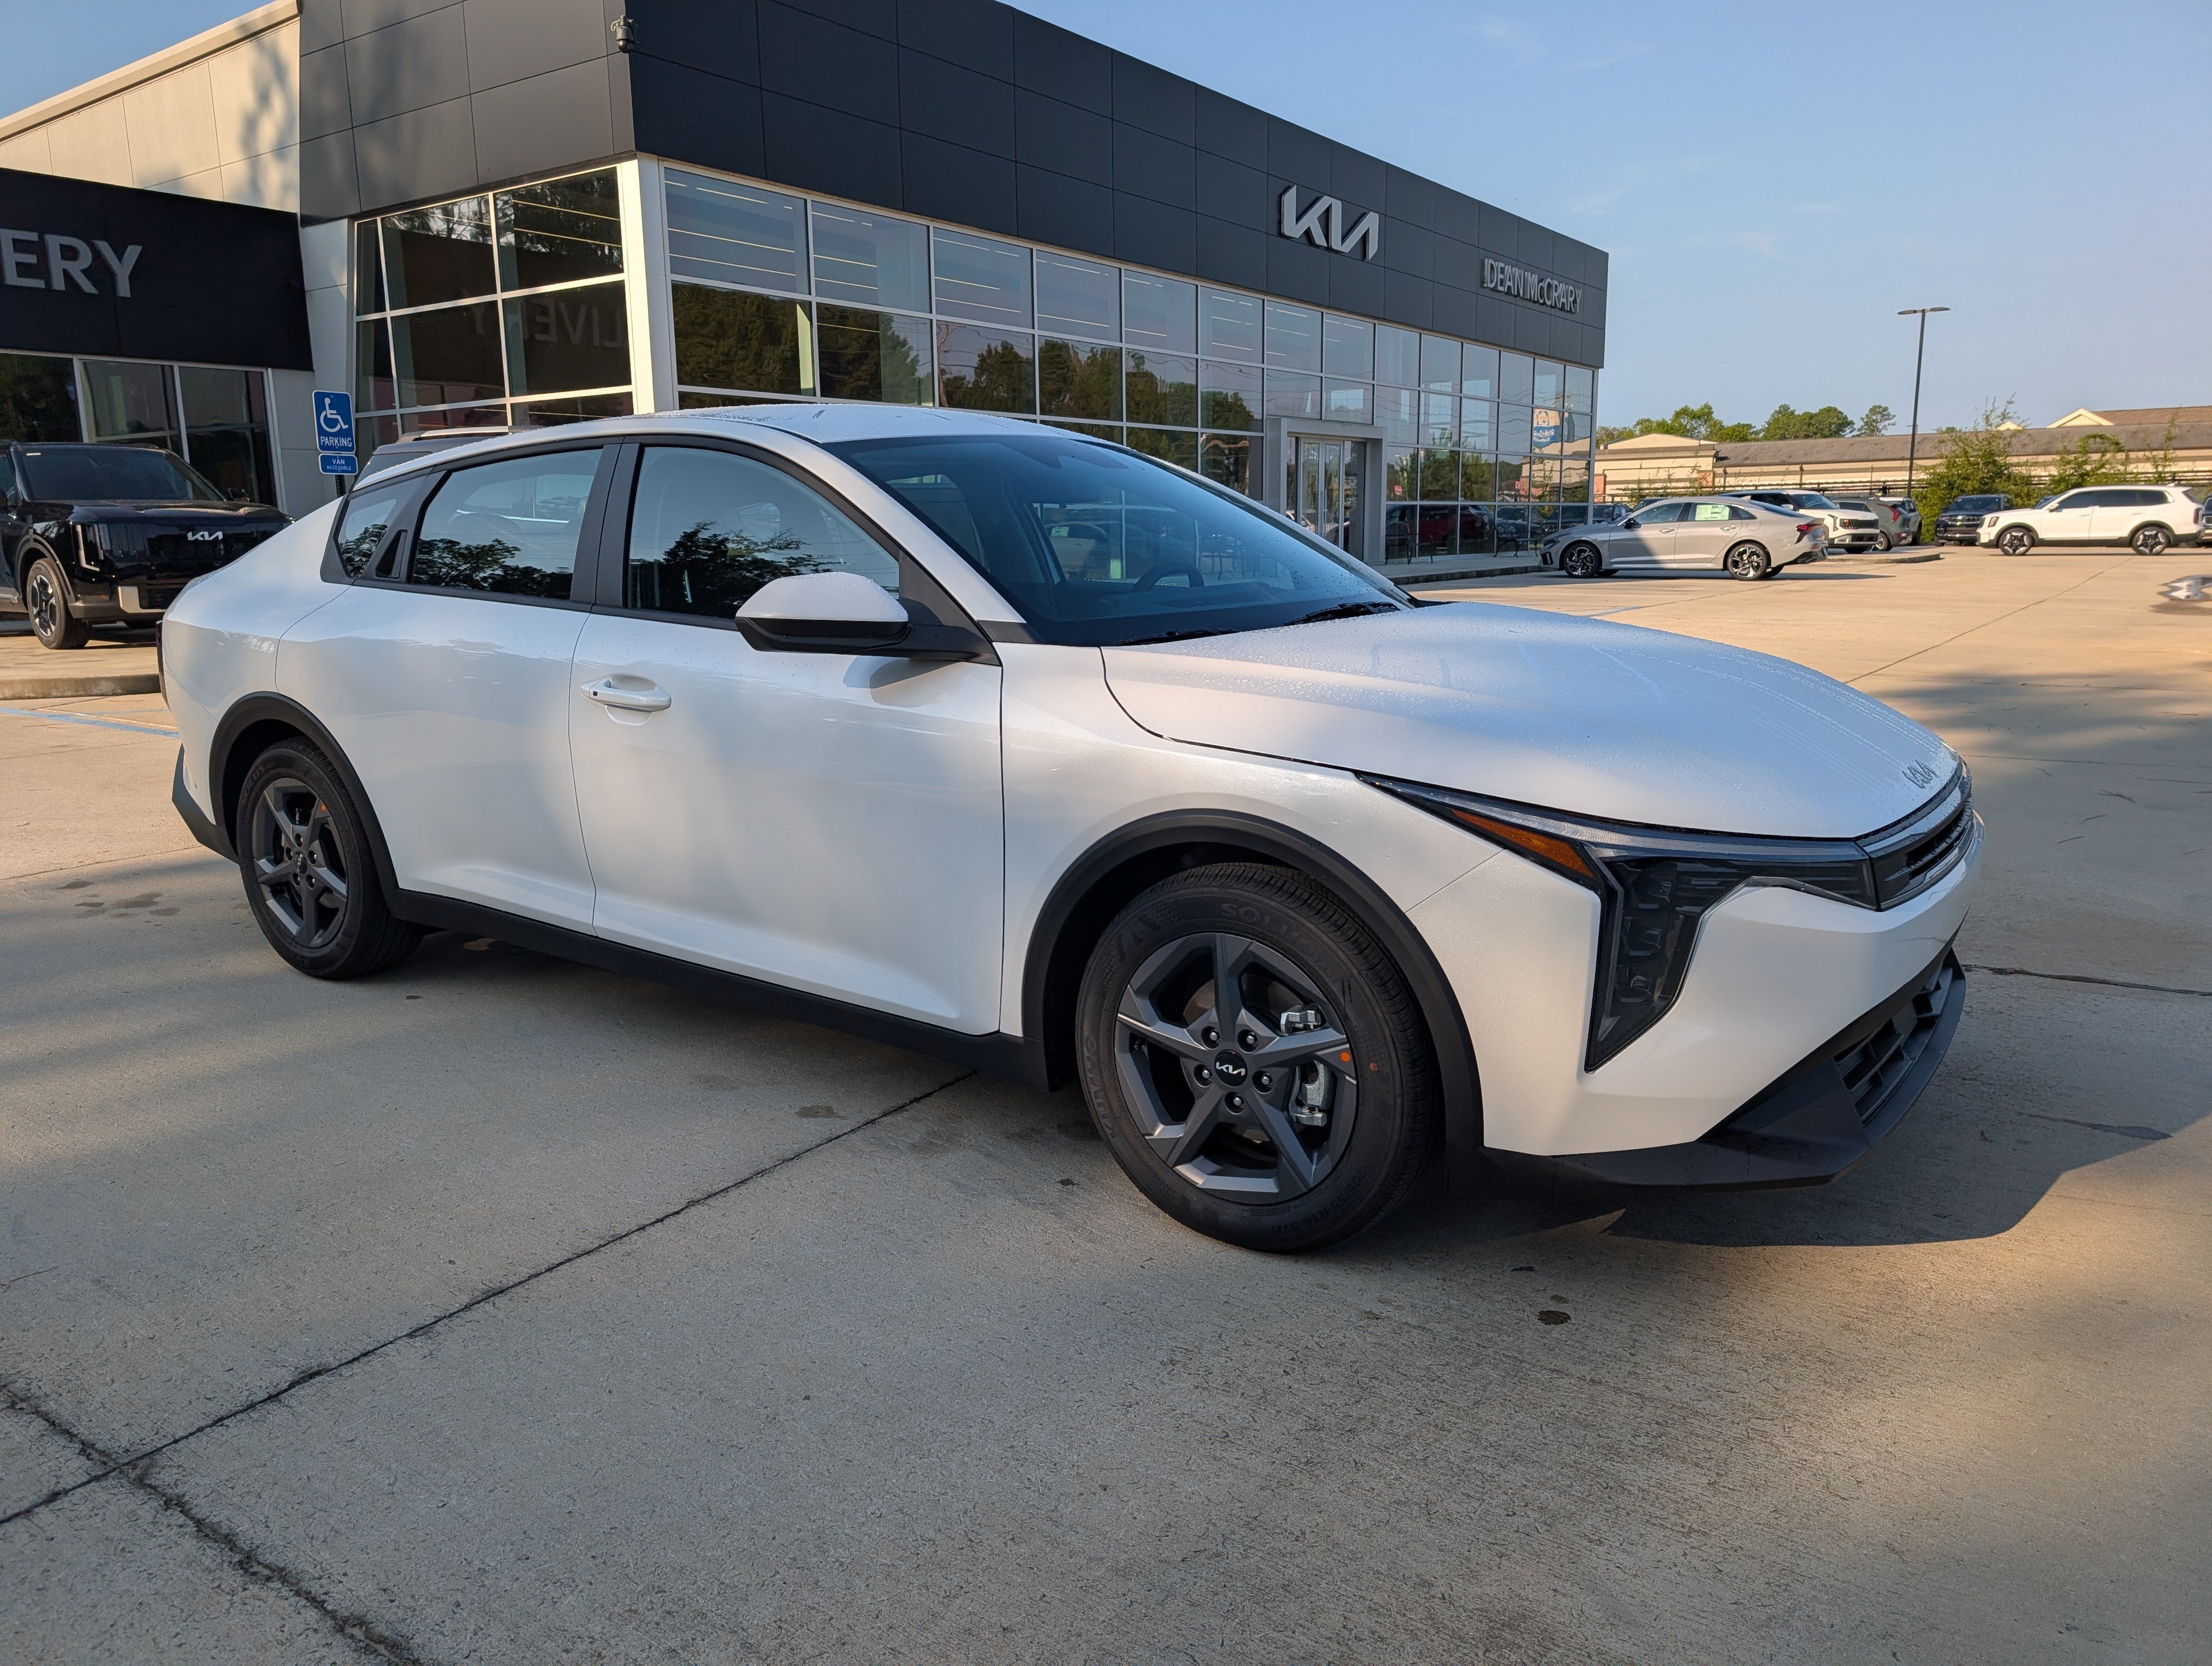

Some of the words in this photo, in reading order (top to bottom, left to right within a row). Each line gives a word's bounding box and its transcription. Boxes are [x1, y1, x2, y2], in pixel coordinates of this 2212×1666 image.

[1281, 184, 1379, 260] KIA
[0, 228, 143, 298] ERY
[1484, 258, 1524, 298] DEAN
[1526, 272, 1582, 313] McCRARY
[320, 436, 352, 447] PARKING
[187, 531, 223, 541] KIA
[1085, 1034, 1121, 1139] KUMHO
[1216, 1061, 1246, 1077] KIA
